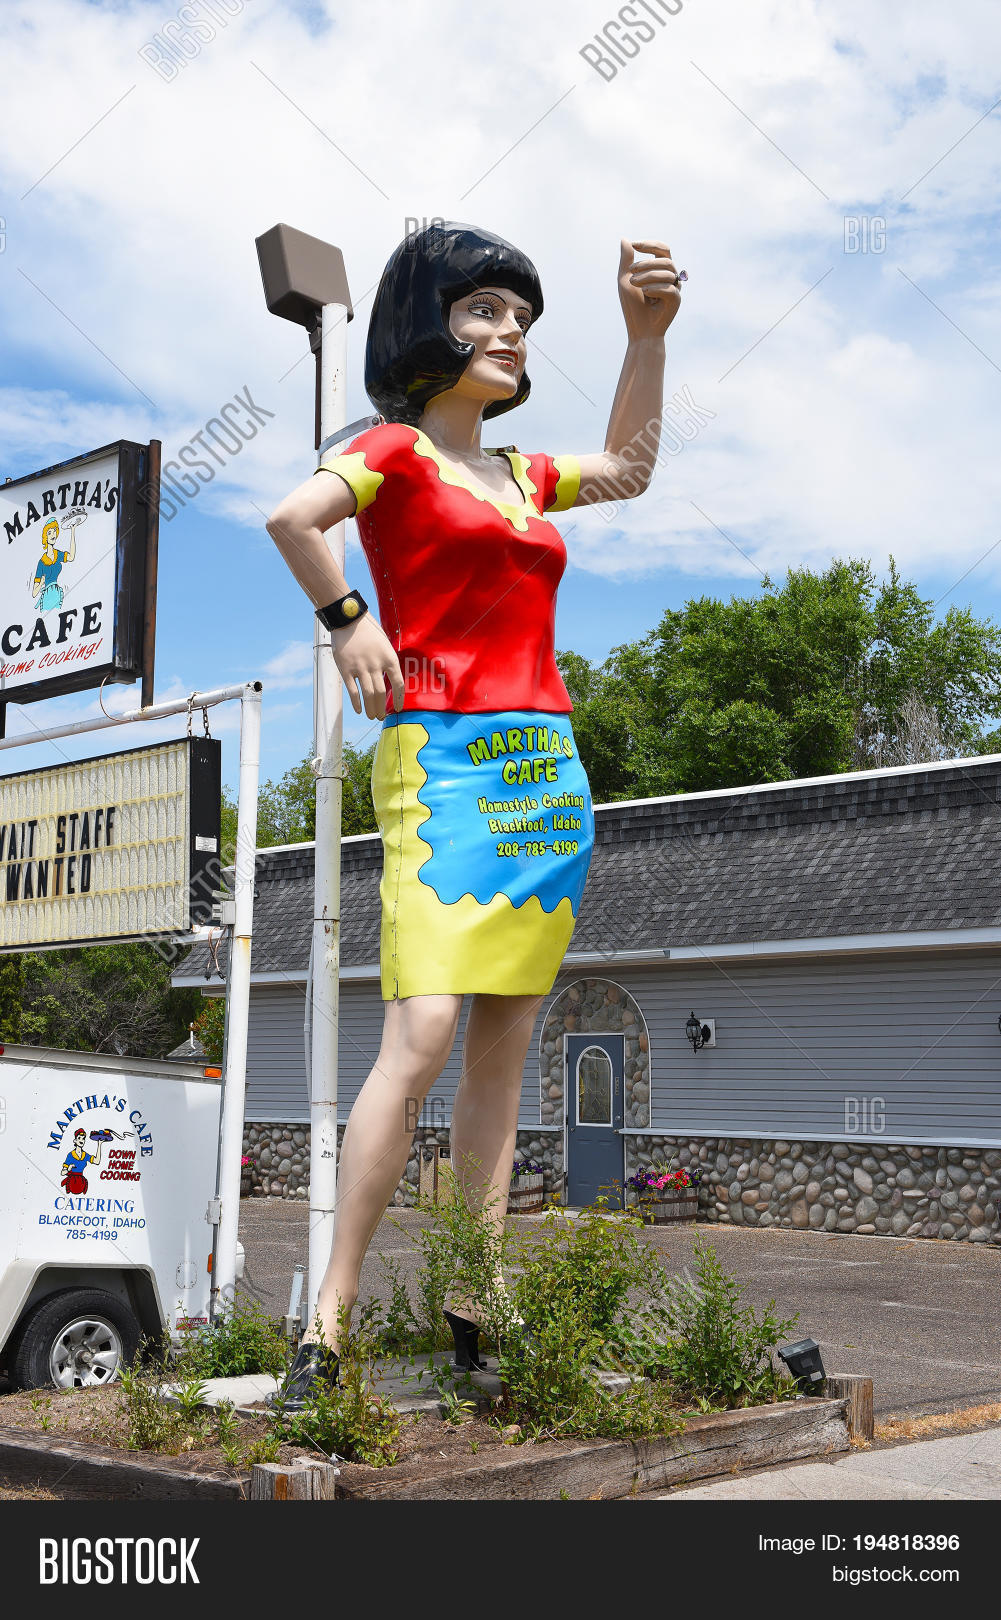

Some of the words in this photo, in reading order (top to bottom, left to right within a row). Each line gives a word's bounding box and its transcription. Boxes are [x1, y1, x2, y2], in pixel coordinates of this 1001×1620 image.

[3, 478, 118, 545] MARTHA'S
[1, 601, 103, 657] CAFE
[38, 638, 103, 669] Cooking!
[466, 726, 574, 766] MARTHAS
[502, 758, 558, 786] CAFE
[477, 795, 538, 815] Homestyle
[542, 791, 585, 811] Cooking
[56, 806, 116, 854] STAFF
[488, 816, 549, 834] Blackfoot,
[552, 814, 582, 832] Idaho
[496, 839, 579, 857] 208-785-4199
[6, 853, 92, 902] WANTED
[46, 1094, 128, 1151] MARTHA'S
[128, 1109, 154, 1158] CAFE
[107, 1159, 135, 1171] HOME
[108, 1149, 137, 1160] DOWN
[100, 1170, 141, 1182] COOKING
[54, 1196, 135, 1214] CATERING
[38, 1214, 109, 1229] BLACKFOOT,
[113, 1217, 146, 1229] IDAHO
[66, 1229, 118, 1241] 785-4199
